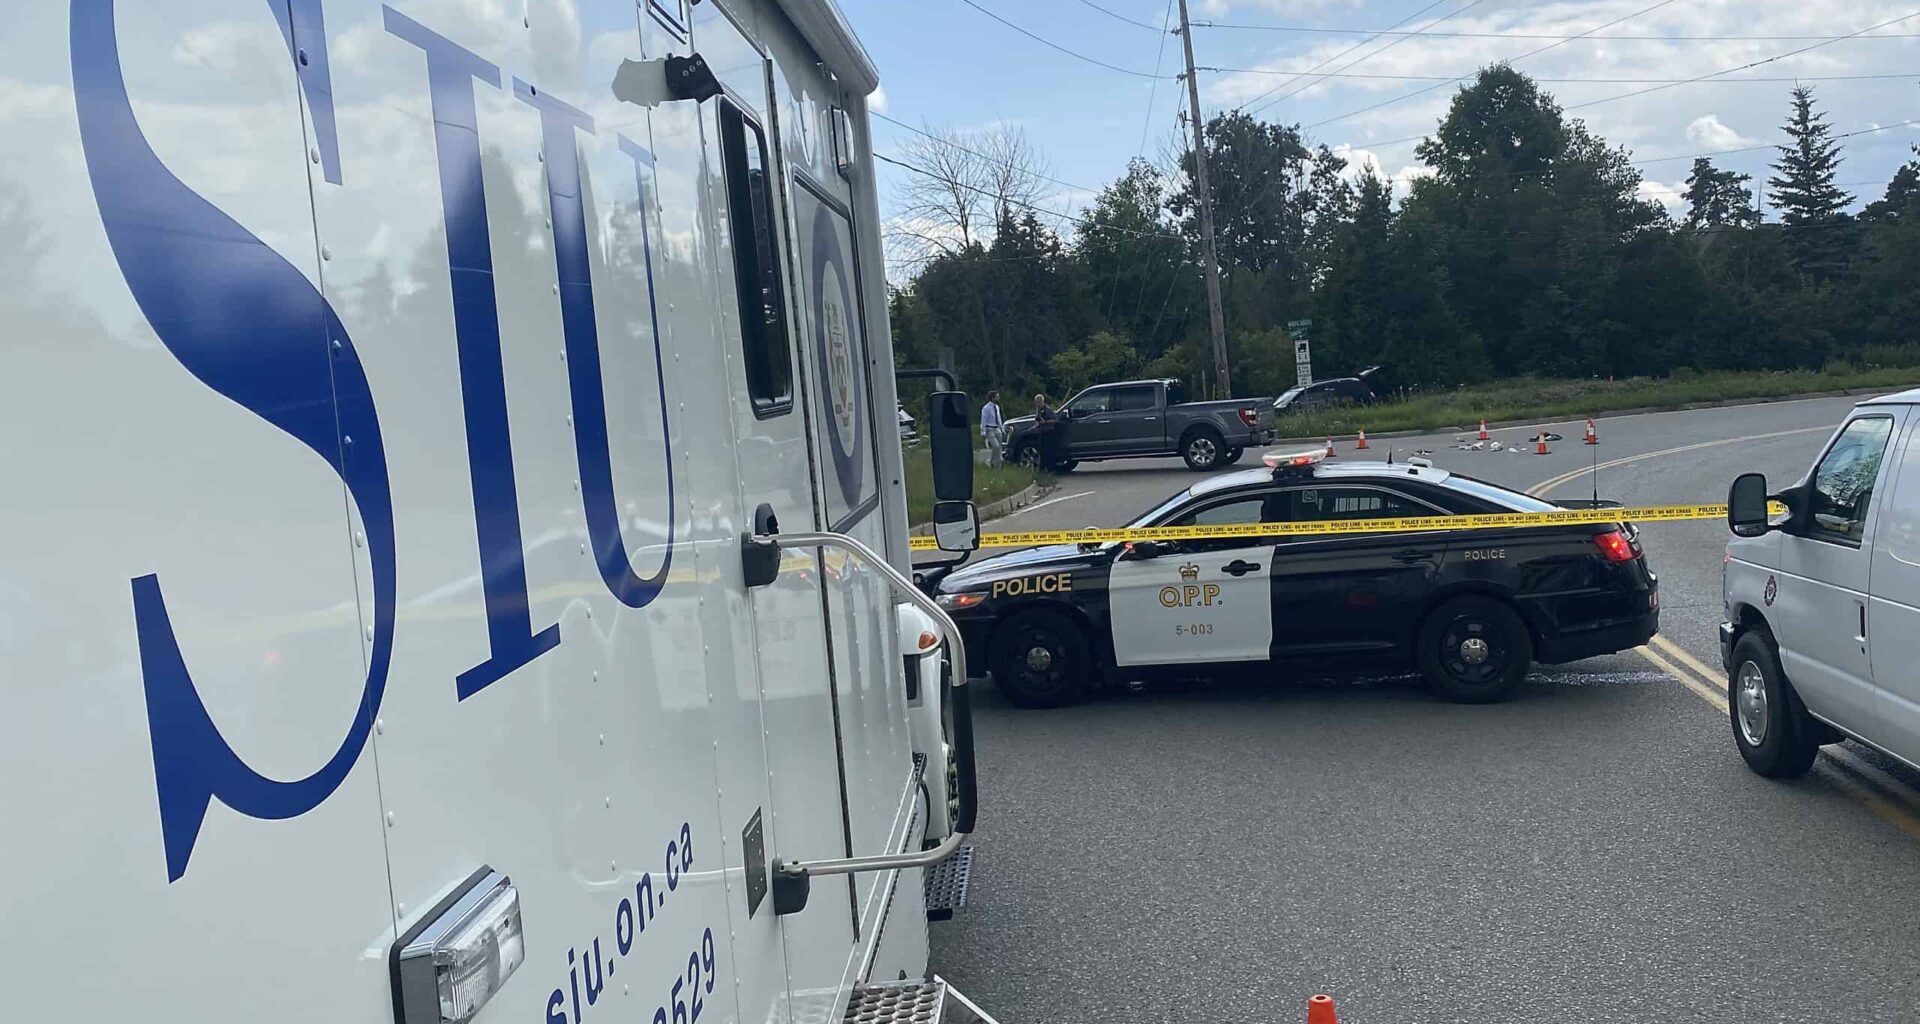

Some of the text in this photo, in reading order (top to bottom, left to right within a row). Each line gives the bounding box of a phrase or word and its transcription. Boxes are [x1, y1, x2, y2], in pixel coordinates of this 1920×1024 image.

[70, 0, 675, 884] SIU
[1464, 549, 1506, 561] POLICE
[992, 572, 1072, 599] POLICE
[1159, 584, 1223, 608] O.P.P.
[1176, 624, 1213, 636] 5-003
